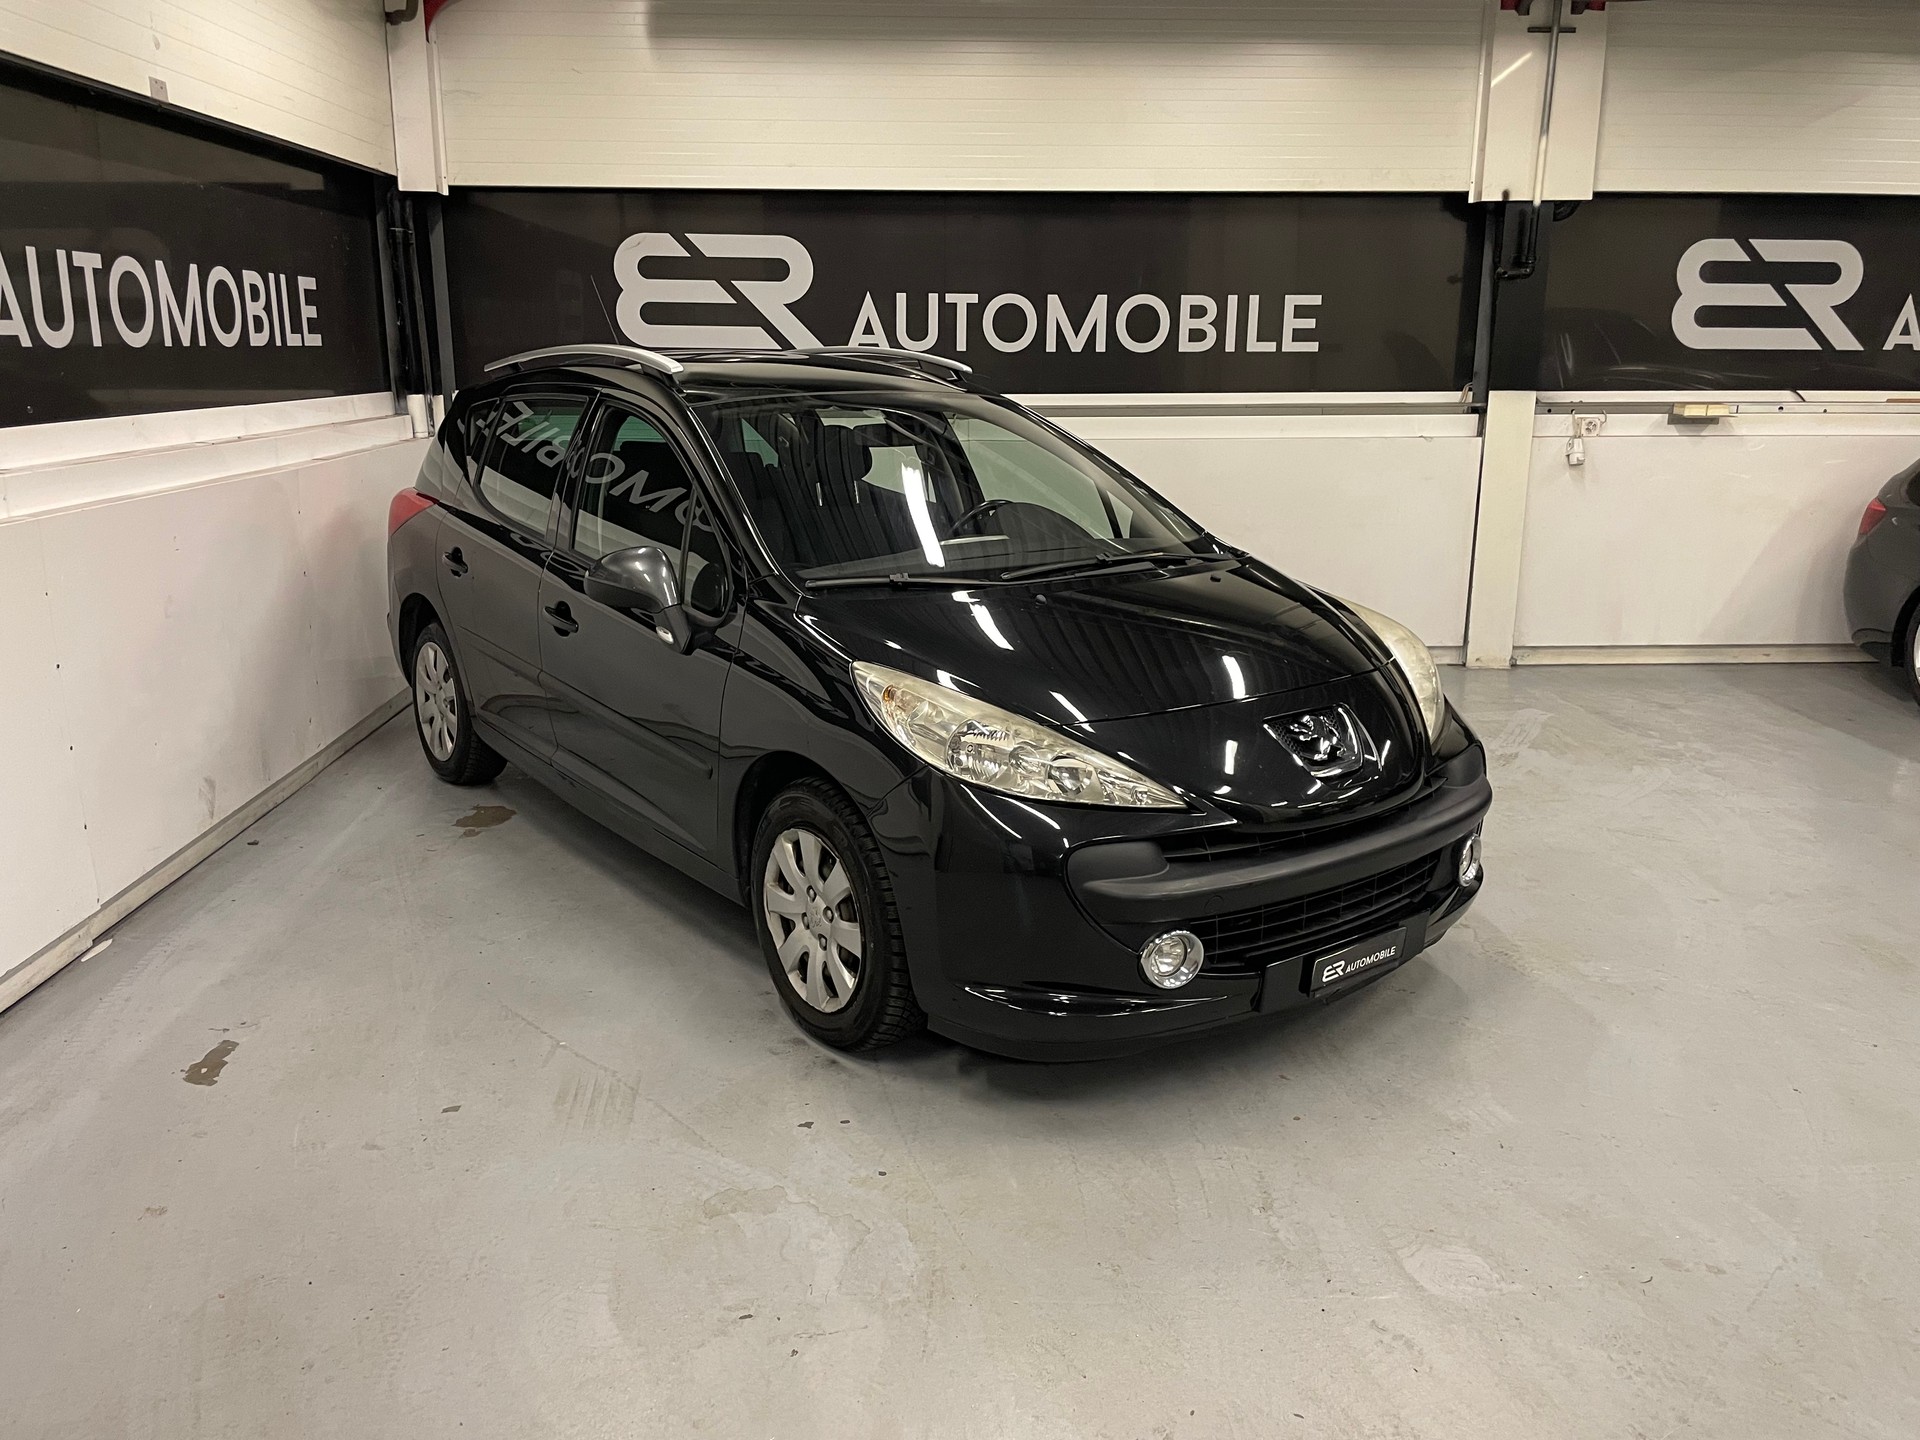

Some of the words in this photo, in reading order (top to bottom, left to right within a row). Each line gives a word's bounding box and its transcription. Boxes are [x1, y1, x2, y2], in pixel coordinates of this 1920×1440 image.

[0, 246, 322, 348] AUTOMOBILE
[847, 290, 1323, 353] AUTOMOBILE
[1345, 945, 1397, 974] AUTOMOBILE
